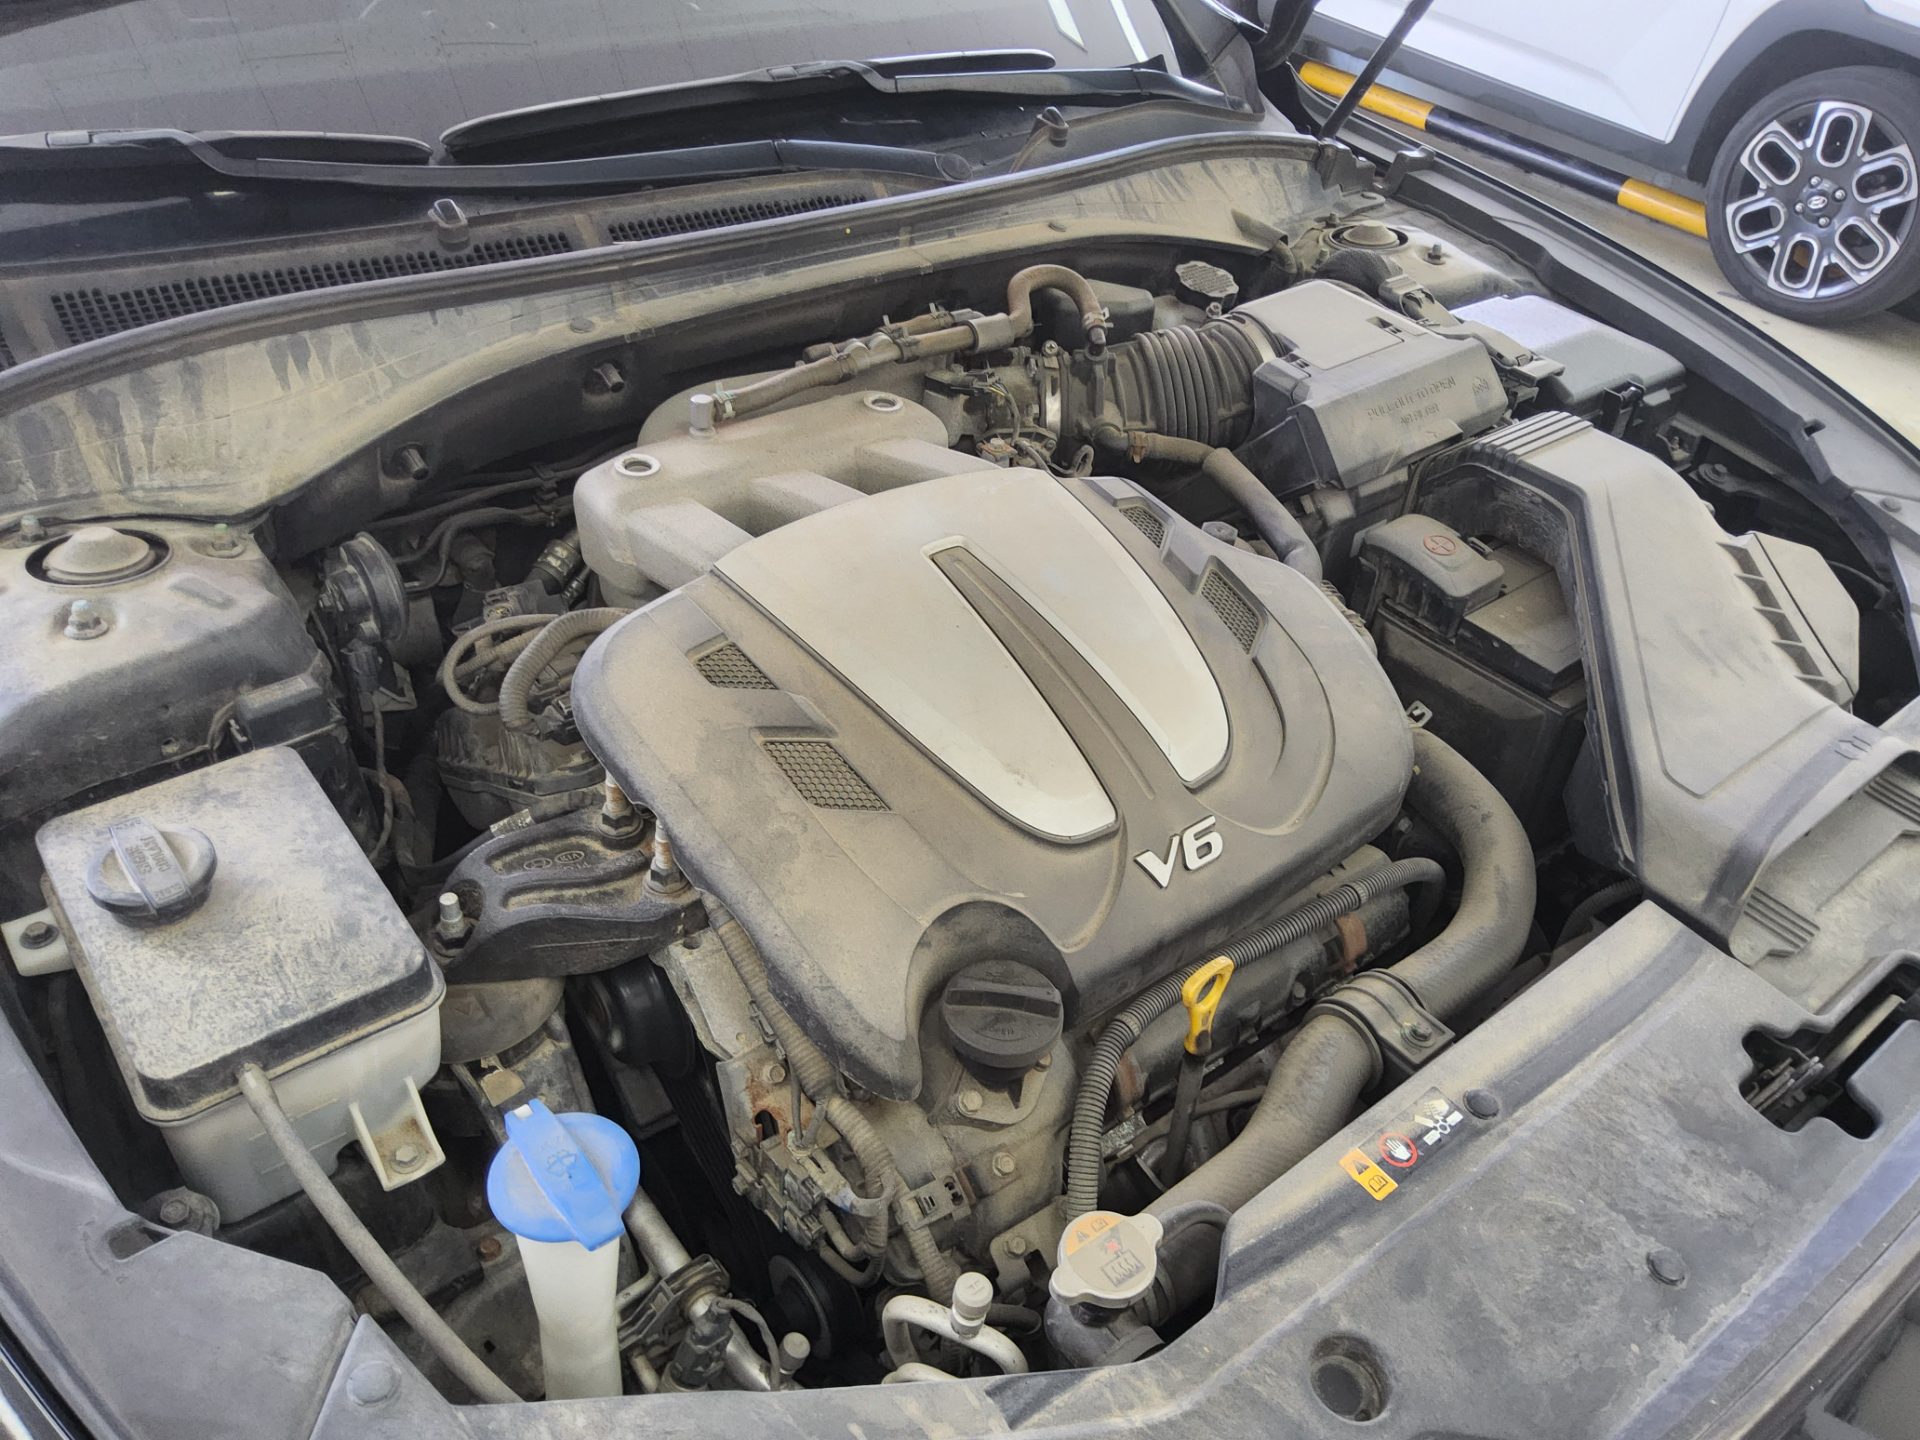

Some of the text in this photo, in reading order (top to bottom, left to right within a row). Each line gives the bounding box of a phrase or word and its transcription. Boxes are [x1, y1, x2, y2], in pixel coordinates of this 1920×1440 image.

[1428, 376, 1456, 393] OPEN
[140, 834, 171, 873] COOLANT
[1133, 815, 1223, 889] V6
